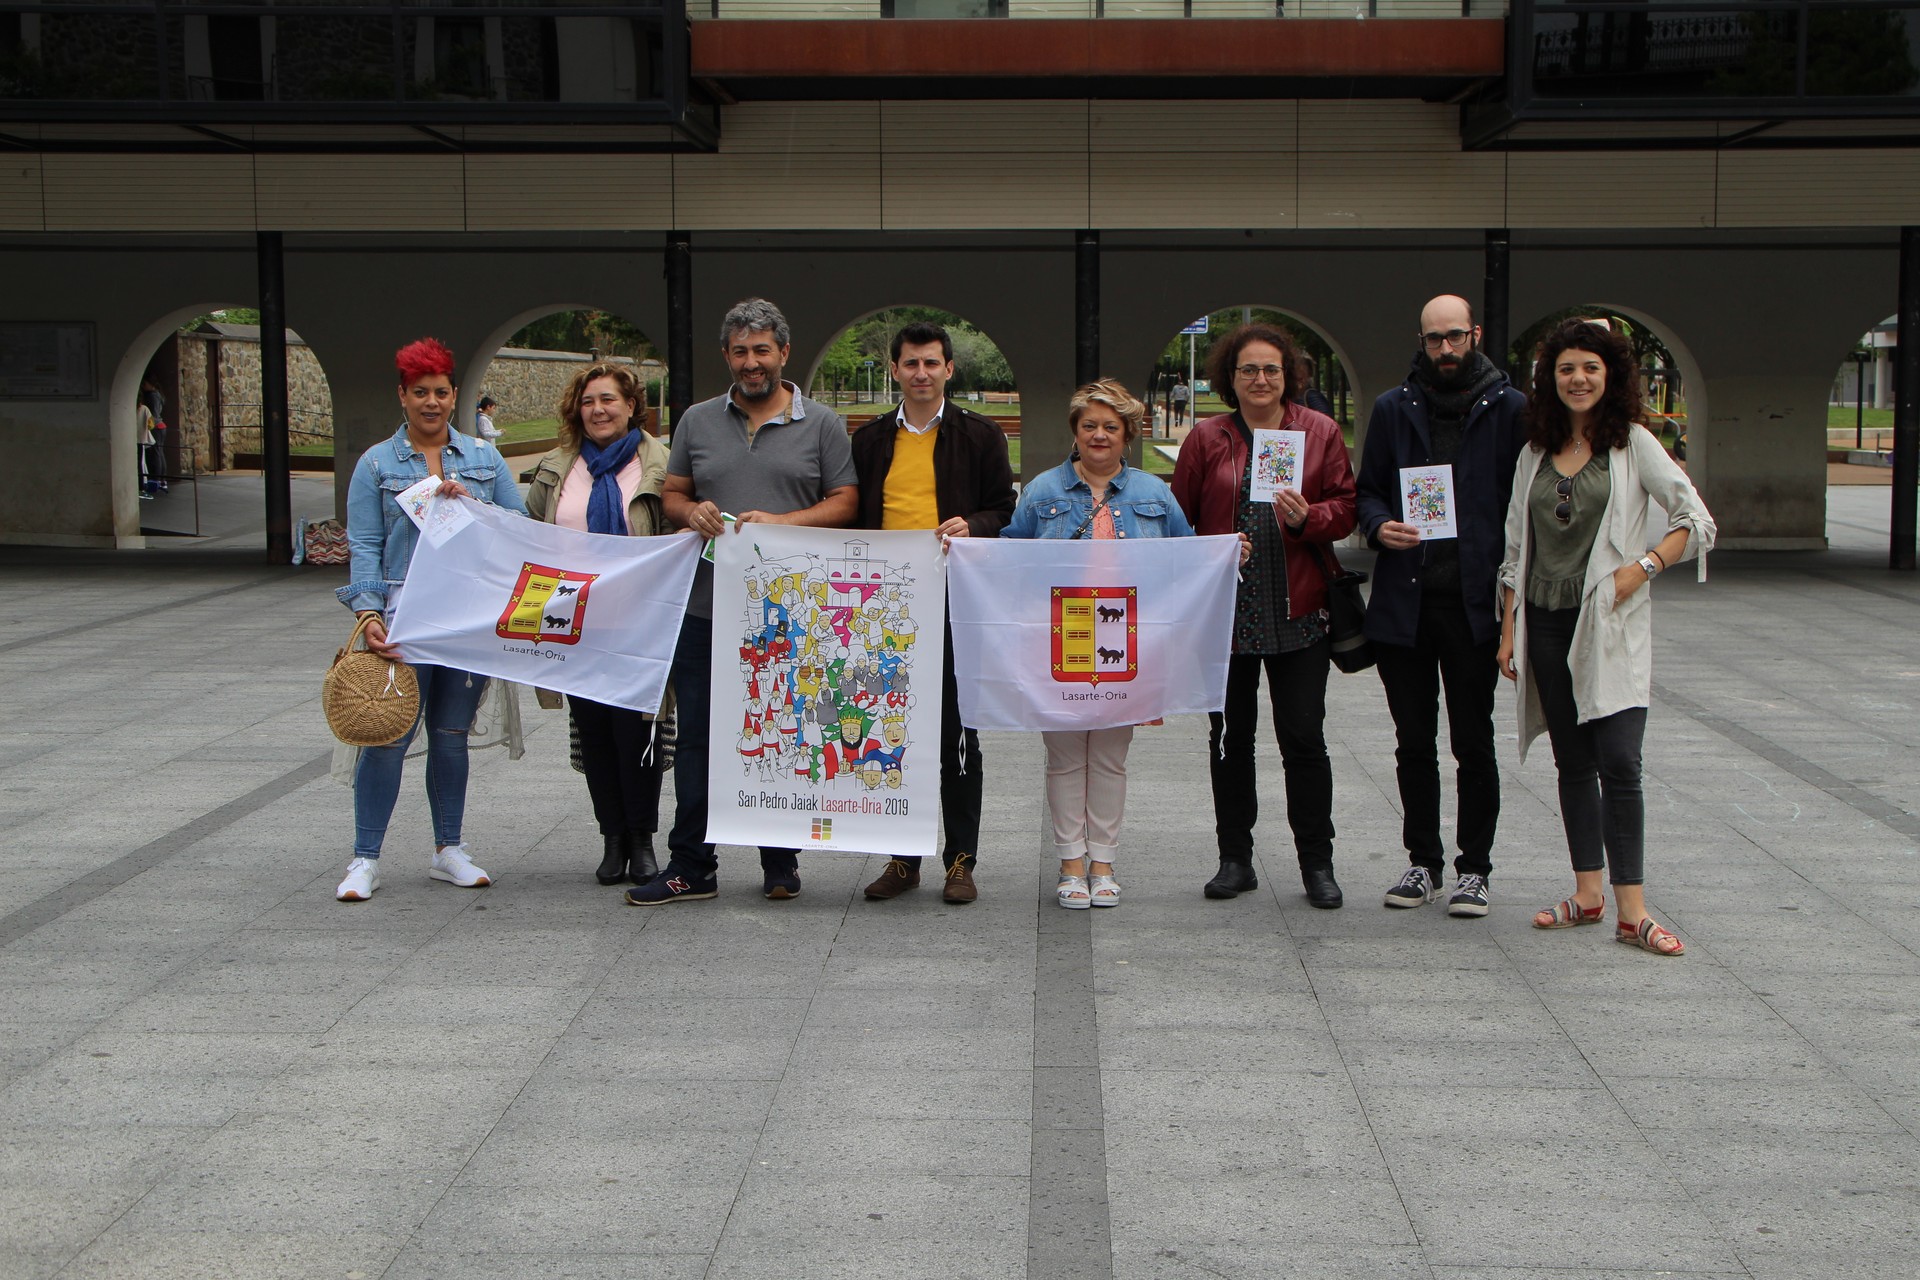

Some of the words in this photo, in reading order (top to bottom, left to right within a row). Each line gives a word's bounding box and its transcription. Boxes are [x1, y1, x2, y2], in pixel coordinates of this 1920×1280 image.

[503, 644, 566, 662] Lasarte-Oria
[1061, 690, 1127, 701] Lasarte-Oria
[738, 789, 757, 808] San
[760, 791, 788, 810] Pedro
[790, 793, 819, 811] Jaiak
[821, 794, 882, 815] Lasarte-Oria
[885, 798, 909, 816] 2019
[666, 875, 691, 894] N
